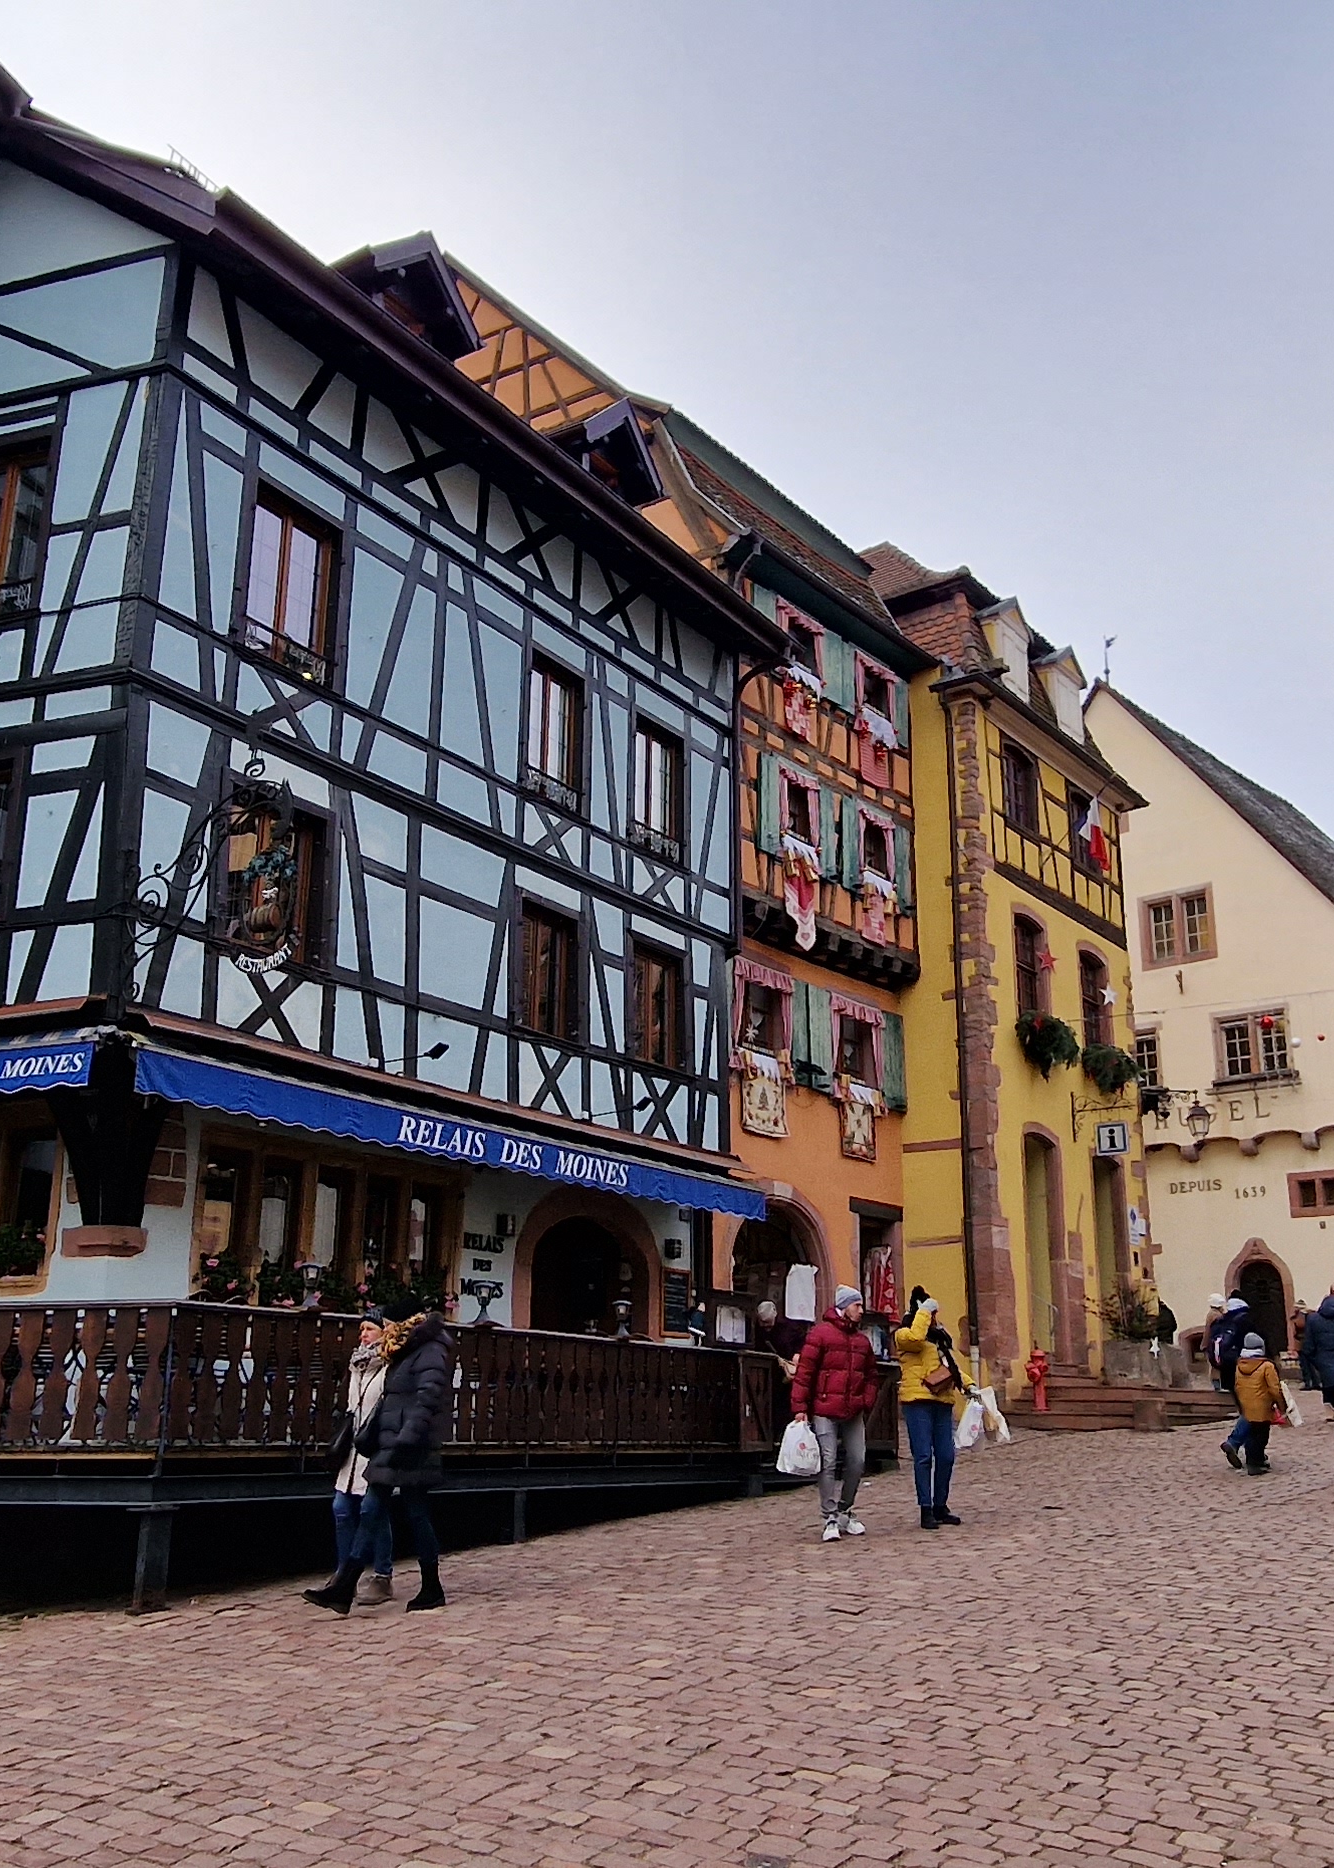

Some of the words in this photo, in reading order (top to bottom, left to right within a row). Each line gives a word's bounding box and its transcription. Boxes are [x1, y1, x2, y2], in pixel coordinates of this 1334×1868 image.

[234, 942, 292, 973] RESTAURANT
[0, 1051, 85, 1080] MOINES
[396, 1115, 487, 1159] RELAIS
[499, 1138, 543, 1171] DES
[554, 1150, 630, 1188] MOINES
[1169, 1179, 1223, 1195] DEPUIS
[1234, 1185, 1267, 1199] 1639
[463, 1232, 505, 1254] RELAIS
[472, 1258, 493, 1272] DES
